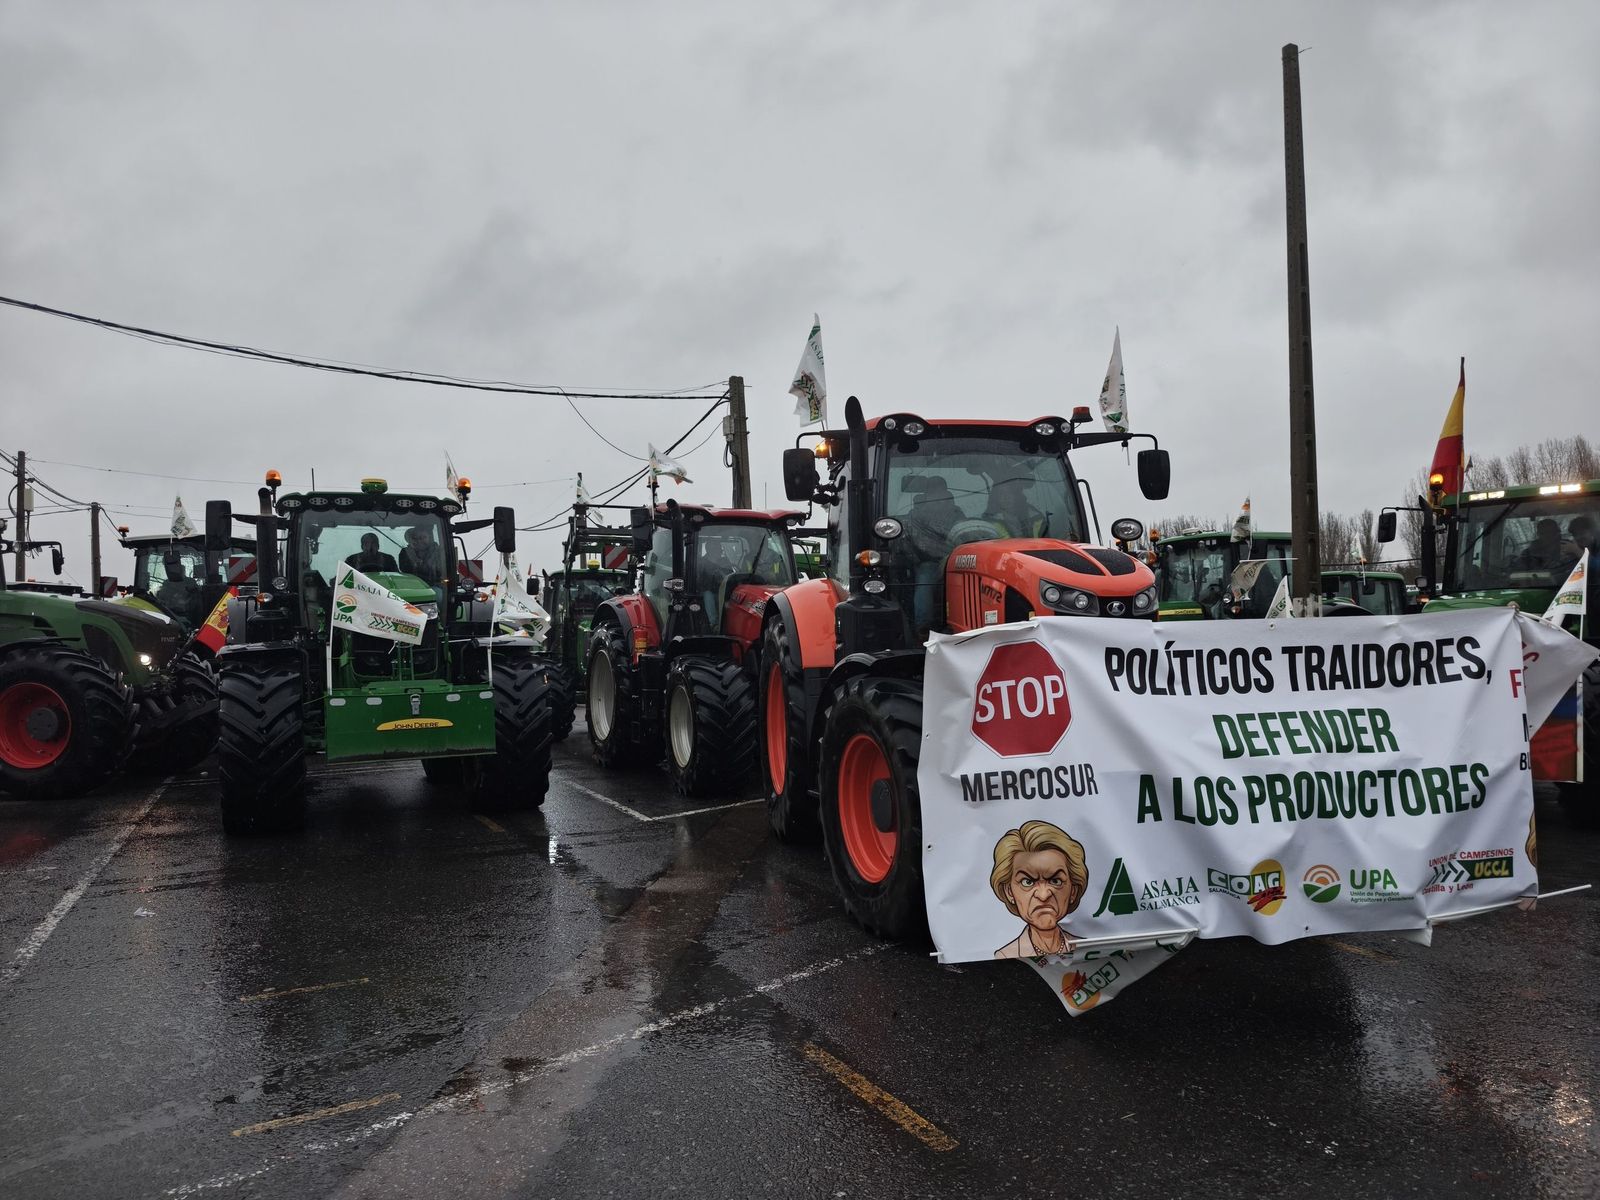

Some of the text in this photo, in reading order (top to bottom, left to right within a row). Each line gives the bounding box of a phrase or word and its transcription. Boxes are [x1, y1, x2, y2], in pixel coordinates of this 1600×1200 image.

[354, 583, 382, 597] ASAJA
[333, 612, 353, 625] UPA
[1104, 641, 1273, 696] POLÍTICOS
[1282, 635, 1493, 691] TRAIDORES,
[975, 674, 1065, 724] STOP
[414, 721, 440, 729] DEERE
[1212, 707, 1401, 760] DEFENDER
[960, 763, 1099, 803] MERCOSUR
[1137, 762, 1490, 826] A LOS PRODUCTORES
[1459, 848, 1514, 859] CAMPESINOS
[1350, 868, 1398, 890] UPA
[1474, 860, 1510, 878] UCCL
[1140, 876, 1200, 901] ASAJA
[1208, 868, 1281, 896] COAG
[1139, 895, 1201, 912] SALAMANCA
